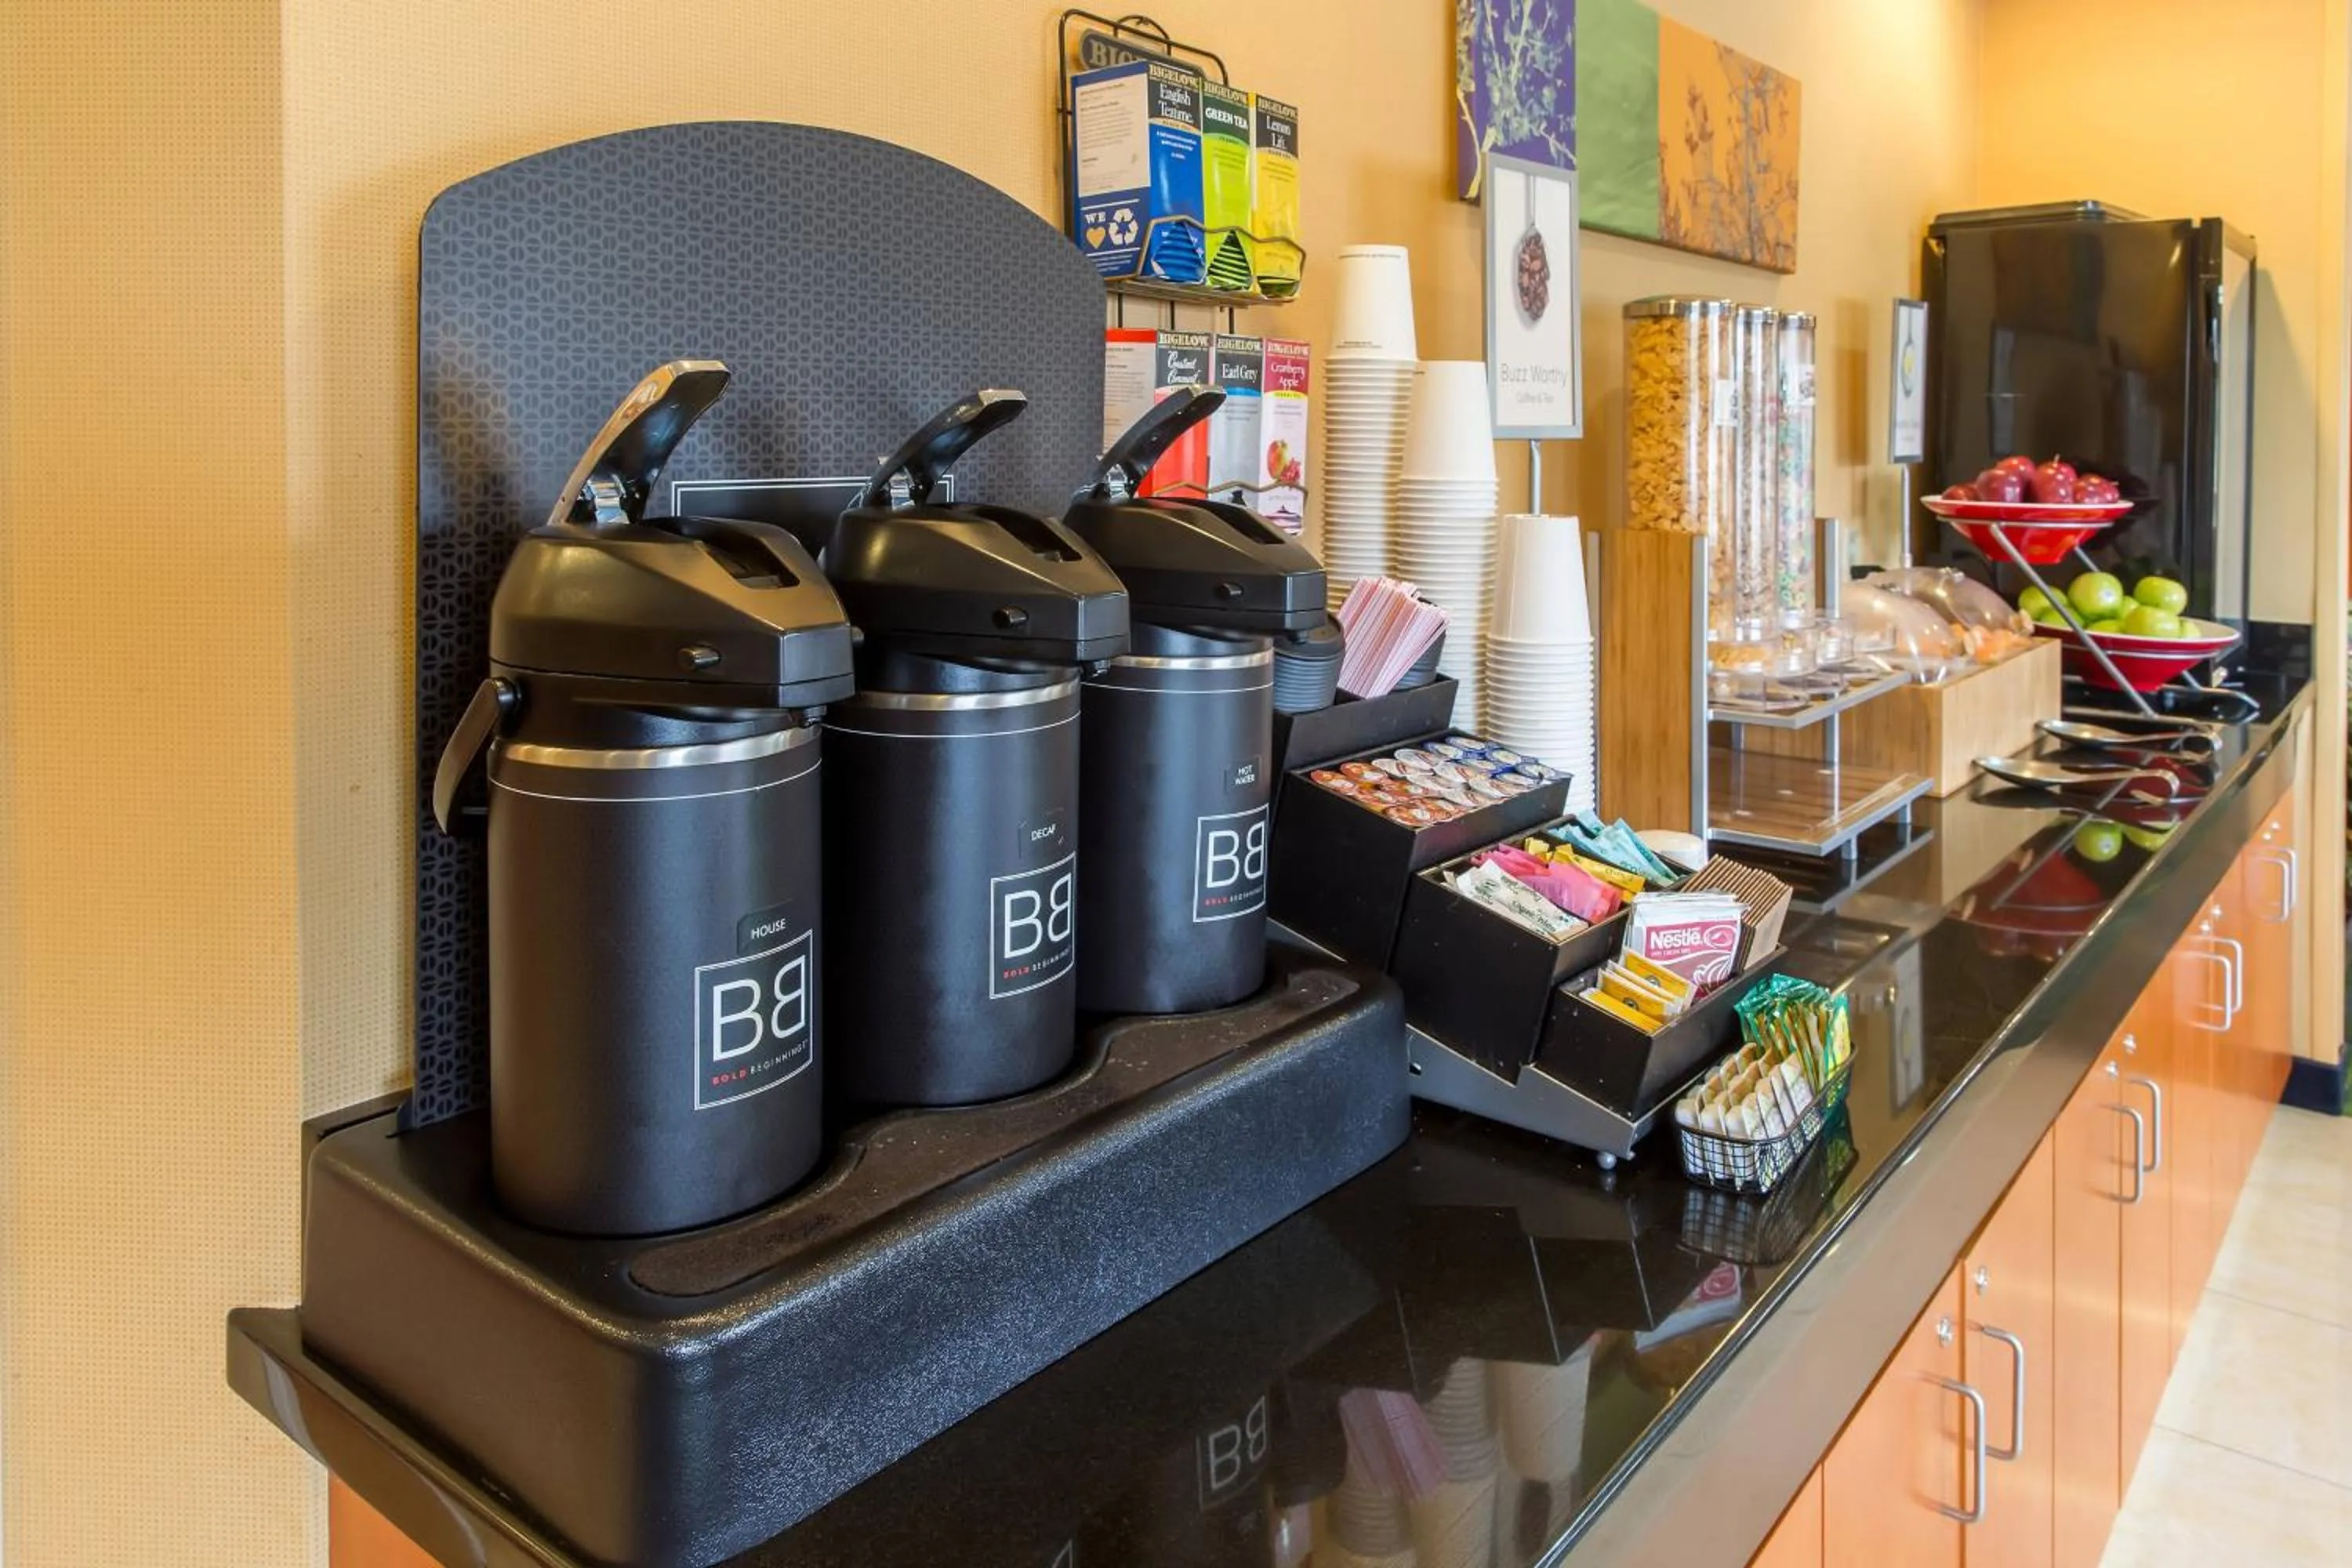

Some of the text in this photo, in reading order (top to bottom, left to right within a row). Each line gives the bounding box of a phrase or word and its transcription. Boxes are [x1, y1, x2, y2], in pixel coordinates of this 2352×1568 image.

[1149, 64, 1200, 88] BIGELOW
[1160, 83, 1191, 106] English
[1205, 107, 1249, 130] GREEN TEA
[1084, 211, 1106, 225] WE
[1160, 333, 1209, 347] BIGELOW
[1218, 338, 1262, 351] BIGELOW
[1267, 342, 1309, 356] BIGELOW
[1222, 363, 1258, 383] Earl Grey
[1270, 360, 1305, 380] Cranberry
[1501, 363, 1567, 389] Buzz Worthy
[1279, 376, 1299, 391] Apple
[1238, 764, 1252, 776] HOT
[1031, 824, 1056, 840] DECAF
[751, 918, 786, 939] HOUSE
[1650, 927, 1700, 949] Nestlé
[712, 1067, 747, 1086] BOLD
